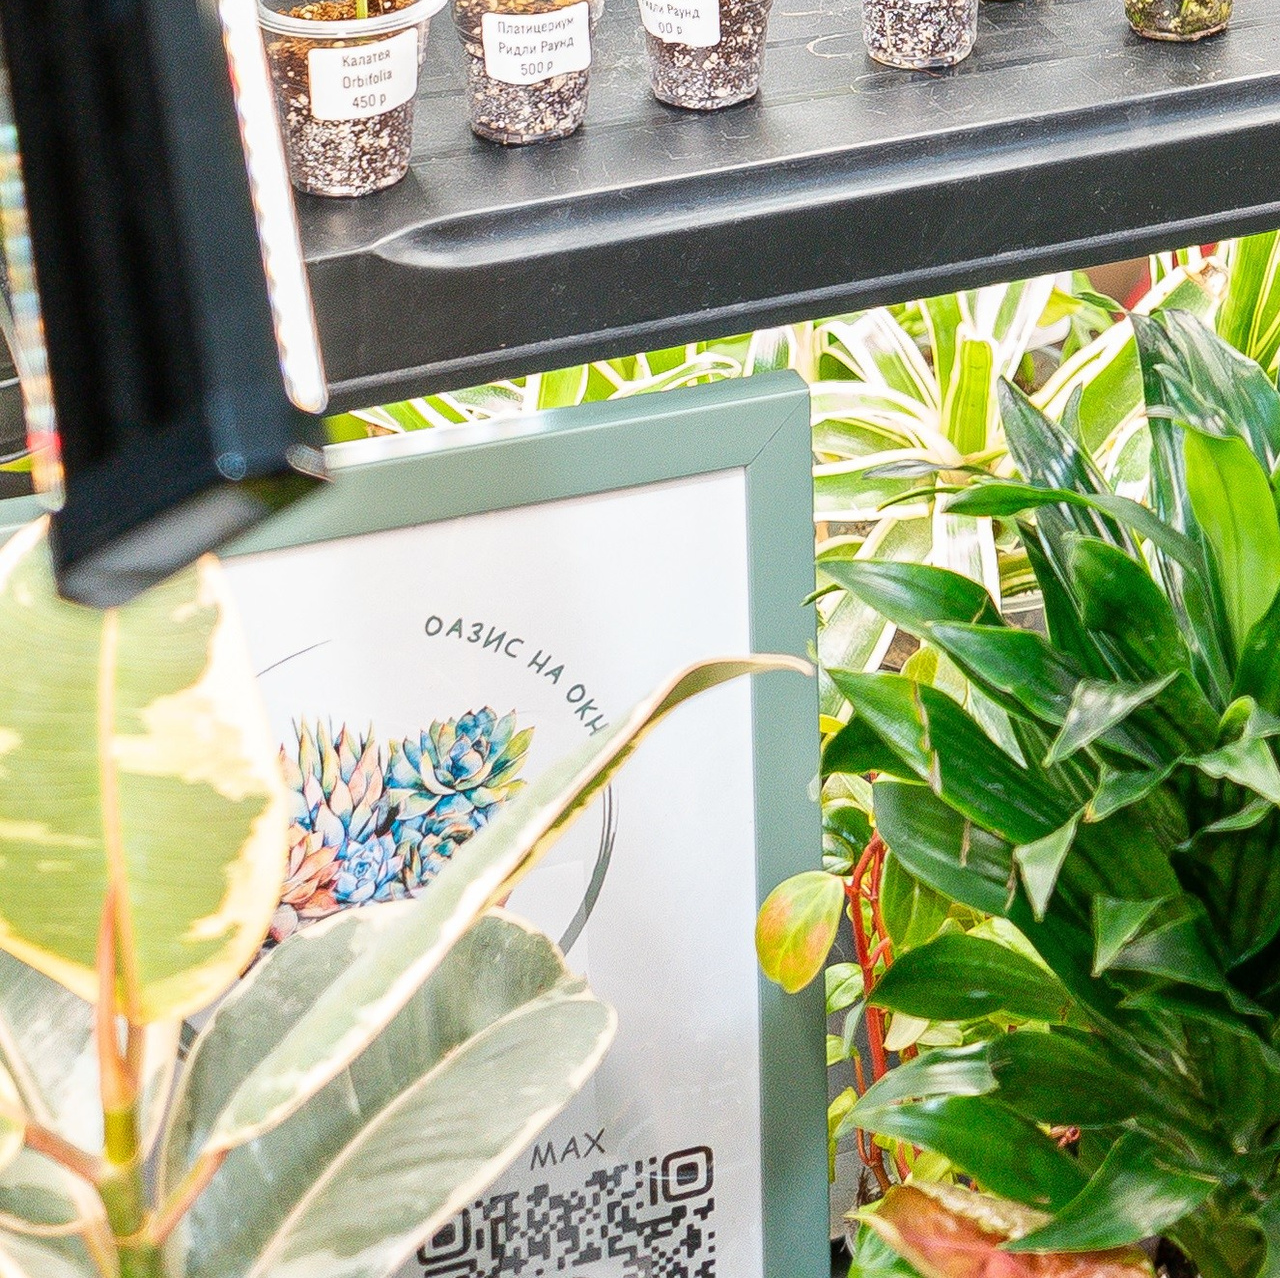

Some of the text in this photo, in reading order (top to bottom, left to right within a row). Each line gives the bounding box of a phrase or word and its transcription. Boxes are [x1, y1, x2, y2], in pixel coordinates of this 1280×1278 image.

[667, 3, 701, 19] Раунд
[498, 17, 574, 35] Платицериум
[498, 36, 575, 57] Ридли Раунд
[342, 49, 391, 67] Калатея
[520, 61, 544, 76] 500
[342, 69, 393, 89] Orbifolia
[352, 93, 377, 109] 450
[424, 615, 525, 658] ОАЗИС
[527, 649, 565, 684] НА
[530, 1127, 606, 1171] MAX
